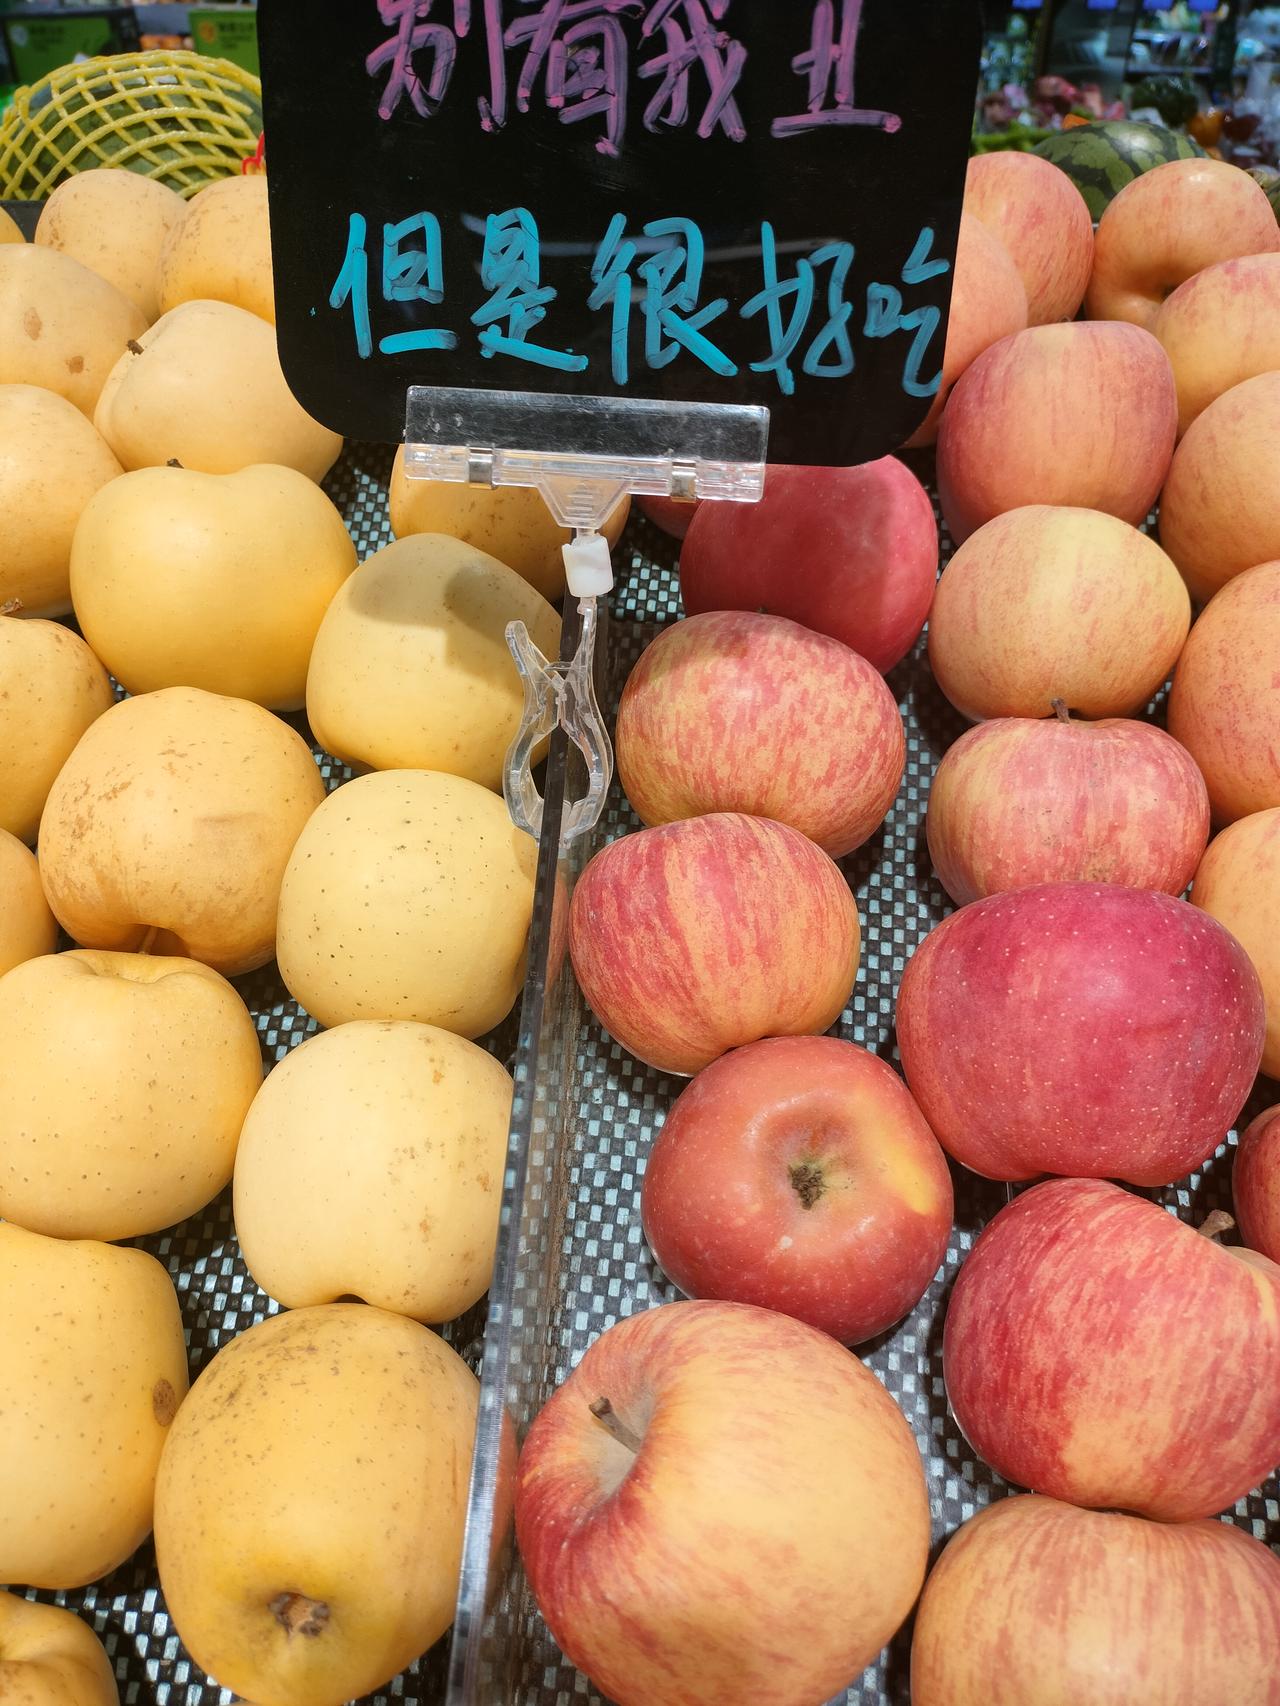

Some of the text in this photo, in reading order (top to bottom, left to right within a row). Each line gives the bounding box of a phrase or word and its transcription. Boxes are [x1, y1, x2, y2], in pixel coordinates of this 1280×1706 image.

[329, 207, 950, 397] 但是很好吃
